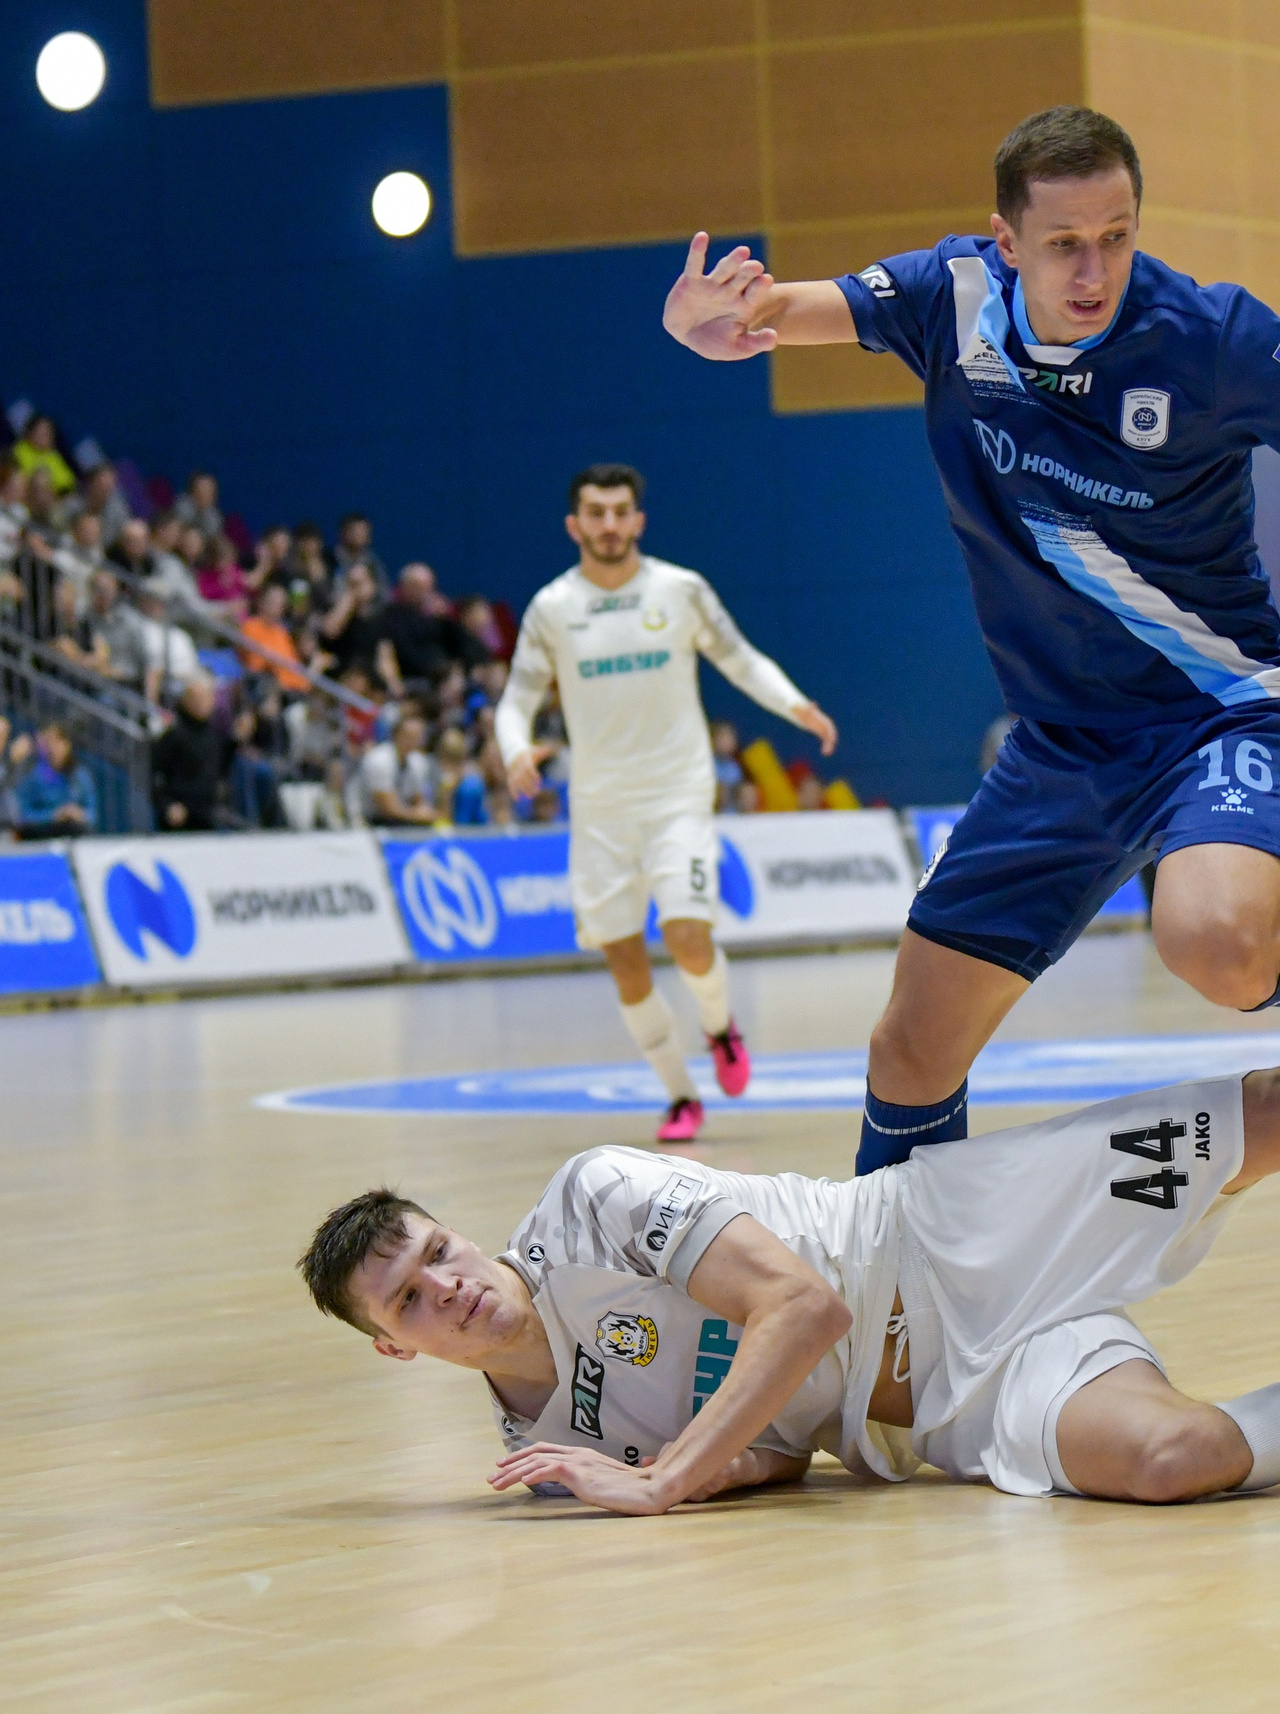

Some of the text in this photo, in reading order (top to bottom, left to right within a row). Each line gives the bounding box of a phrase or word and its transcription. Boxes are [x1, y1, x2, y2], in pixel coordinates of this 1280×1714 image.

[858, 265, 896, 298] RI
[1021, 453, 1155, 510] НОРНИКЕЛЬ
[578, 650, 671, 679] СИБУР
[1197, 738, 1274, 792] 16
[1210, 804, 1255, 815] KELME
[690, 857, 706, 892] 5
[1195, 1112, 1210, 1161] JAKO
[1110, 1118, 1190, 1210] 44
